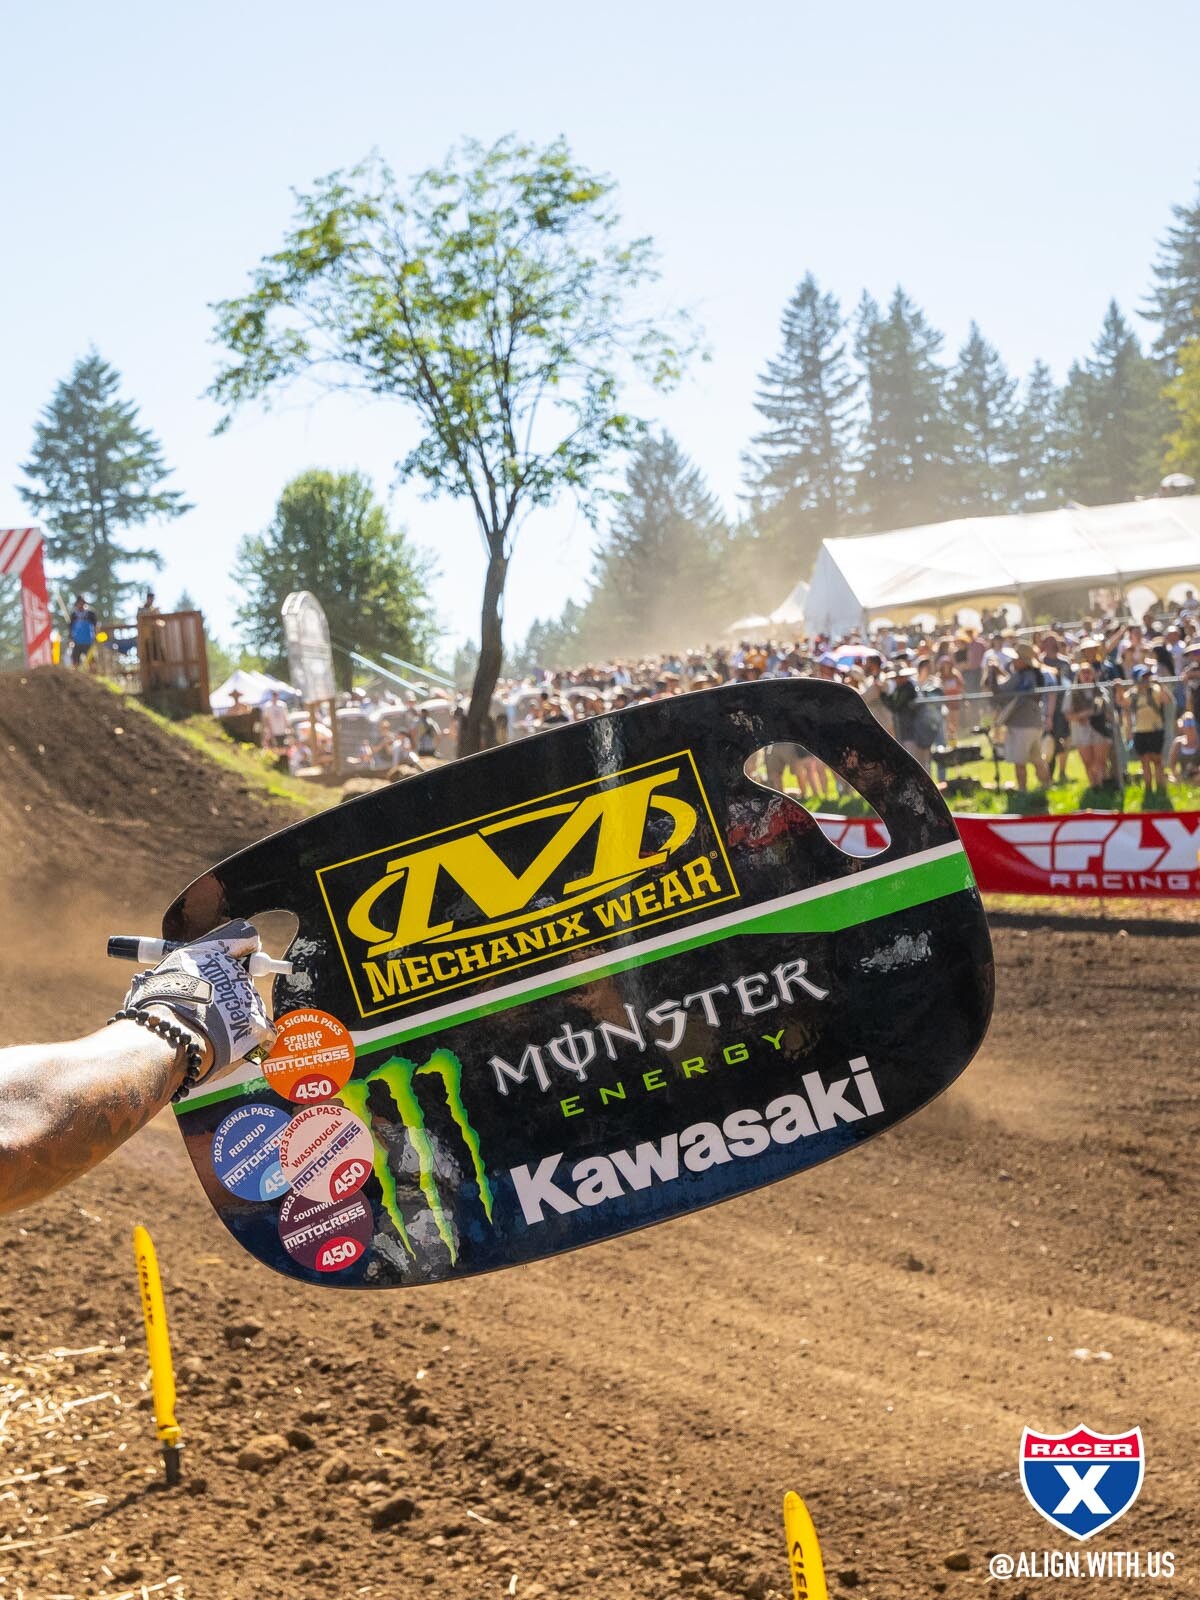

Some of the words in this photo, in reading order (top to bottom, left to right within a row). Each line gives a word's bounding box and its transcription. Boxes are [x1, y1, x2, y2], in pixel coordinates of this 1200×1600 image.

[1050, 872, 1191, 891] RACING
[362, 912, 590, 1003] MECHANIX
[283, 1030, 323, 1047] SPRING
[284, 1013, 320, 1030] SIGNAL
[320, 1015, 344, 1037] PASS
[263, 1047, 350, 1074] MOTOCROSS
[288, 1038, 322, 1052] CREEK
[295, 1079, 333, 1099] 450
[559, 1028, 786, 1119] ENERGY
[213, 1135, 225, 1164] 2023
[220, 1109, 251, 1136] SIGNAL
[251, 1107, 276, 1118] PASS
[228, 1123, 267, 1158] REDBUD
[280, 1139, 291, 1169] 2023
[286, 1109, 316, 1139] SIGNAL
[316, 1106, 343, 1117] PASS
[291, 1119, 343, 1169] WASHOUGAL
[510, 1055, 885, 1226] Kawasaki
[224, 1131, 286, 1189] MOTOCRO
[293, 1123, 362, 1192] MOTOCROSS
[264, 1173, 287, 1194] 45
[334, 1161, 366, 1195] 450
[280, 1195, 296, 1222] 2023
[283, 1204, 366, 1250] MOTOCROSS
[321, 1241, 357, 1266] 450
